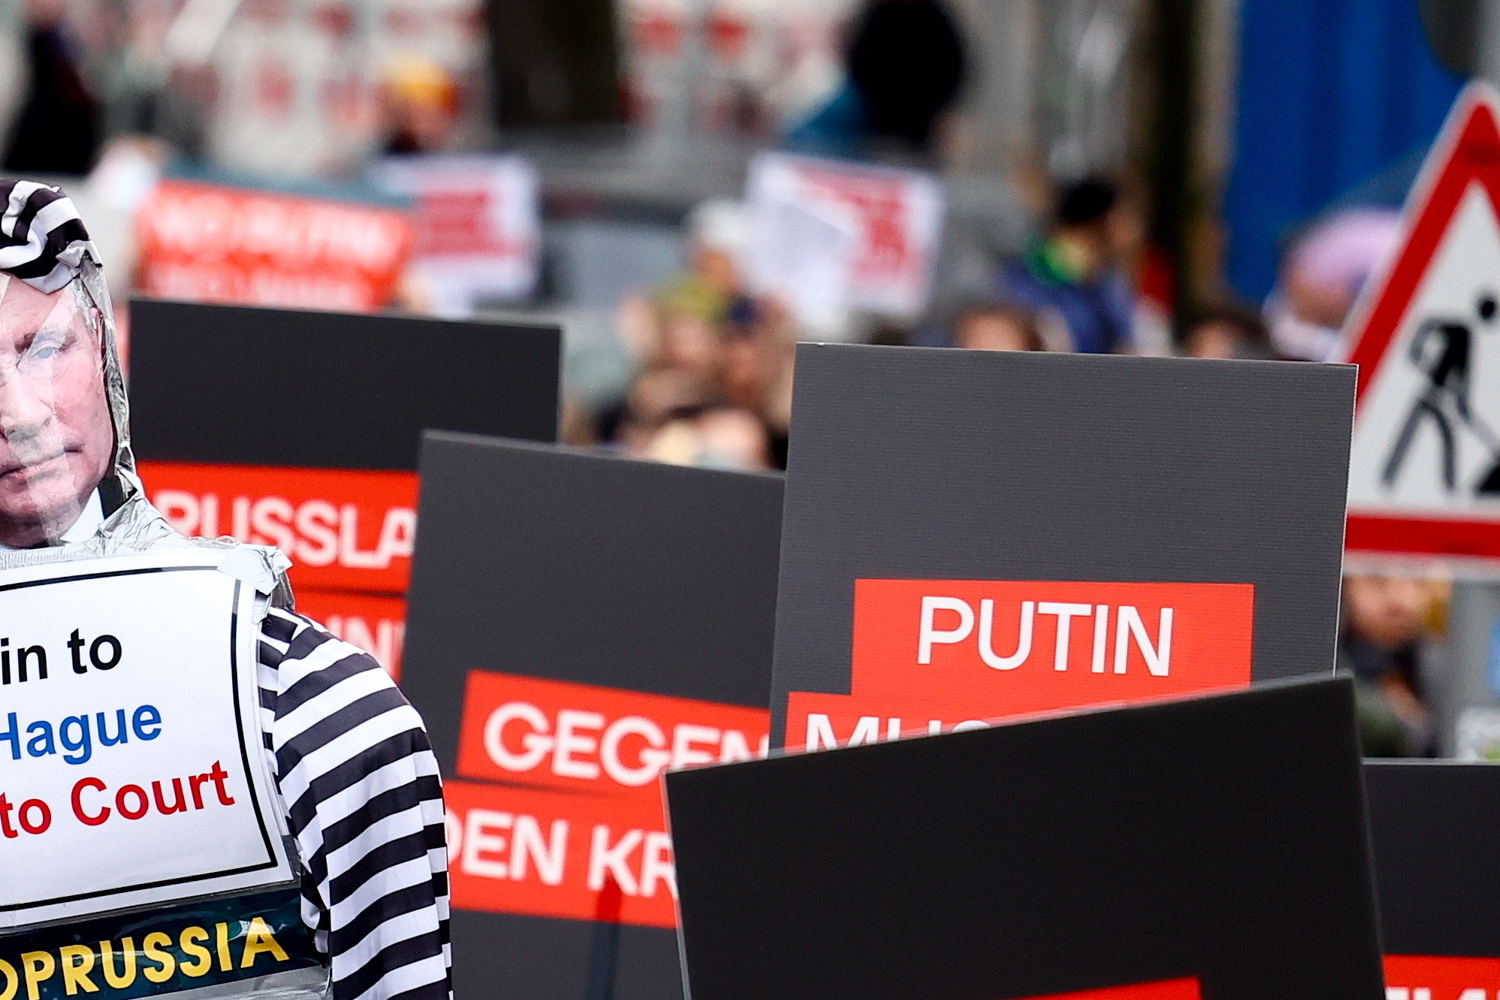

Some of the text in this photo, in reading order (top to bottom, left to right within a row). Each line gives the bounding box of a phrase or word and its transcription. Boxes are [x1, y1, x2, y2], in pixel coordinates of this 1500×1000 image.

[66, 627, 123, 675] to
[917, 595, 1174, 677] PUTIN
[70, 760, 236, 827] Court
